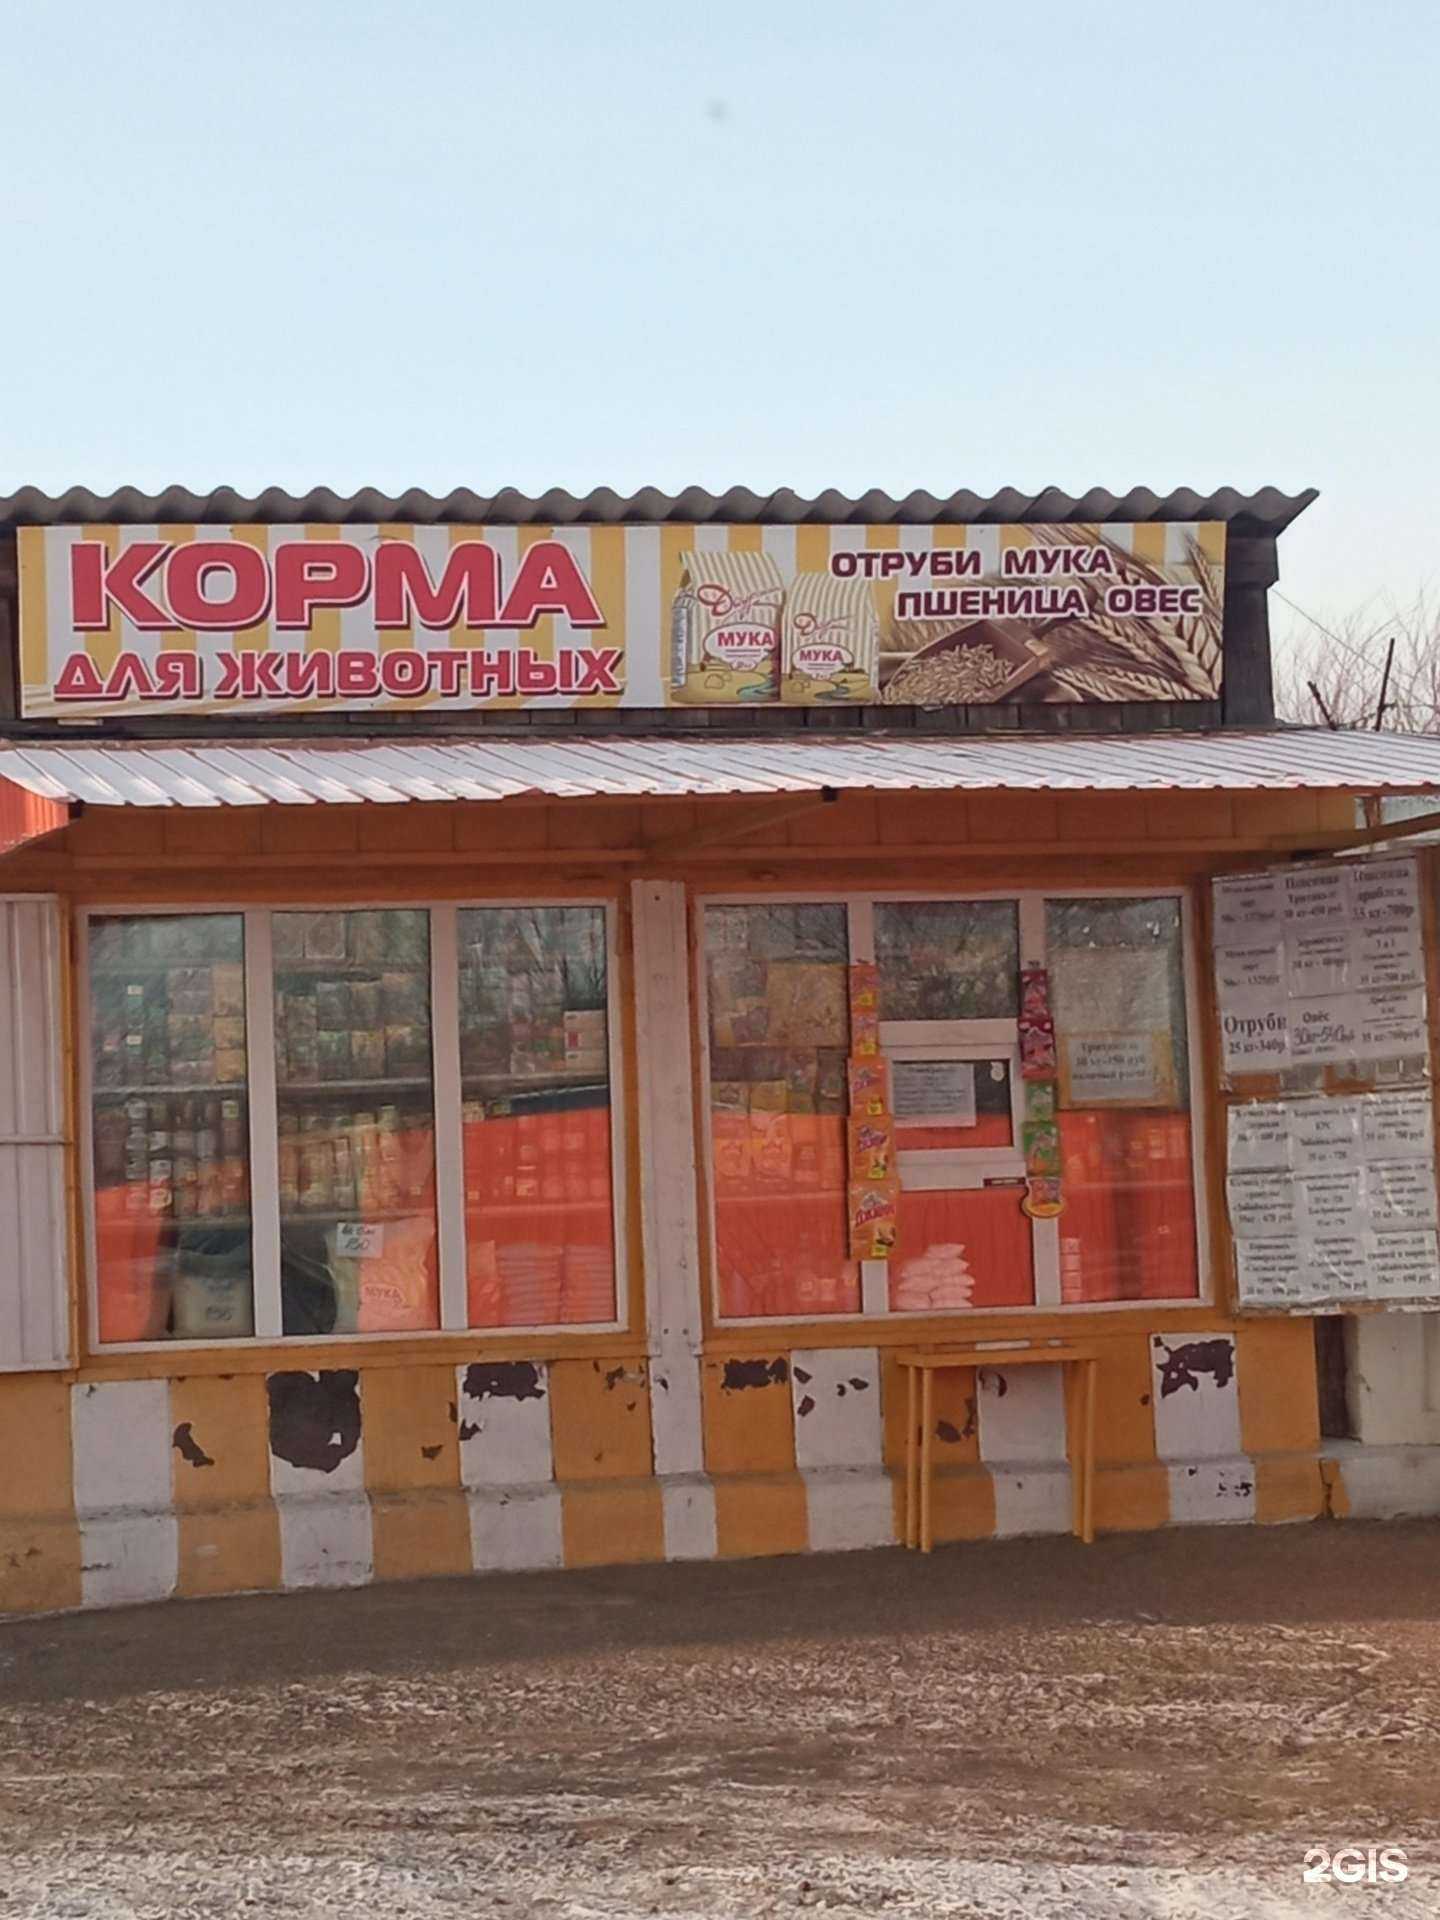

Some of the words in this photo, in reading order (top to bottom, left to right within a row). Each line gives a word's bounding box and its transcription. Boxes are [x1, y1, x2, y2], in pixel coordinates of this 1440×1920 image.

[832, 550, 981, 577] ОТРУБИ
[1003, 548, 1114, 575] МУКА
[70, 540, 604, 630] КОРМА
[898, 588, 1087, 617] ПШЕНИЦА
[1107, 587, 1201, 614] ОВЕС
[717, 631, 774, 647] МУКА
[799, 650, 844, 661] МУКА
[54, 653, 202, 699] ДЛЯ
[215, 648, 625, 698] ЖИВОТНЫХ
[1224, 1012, 1287, 1039] Отруби
